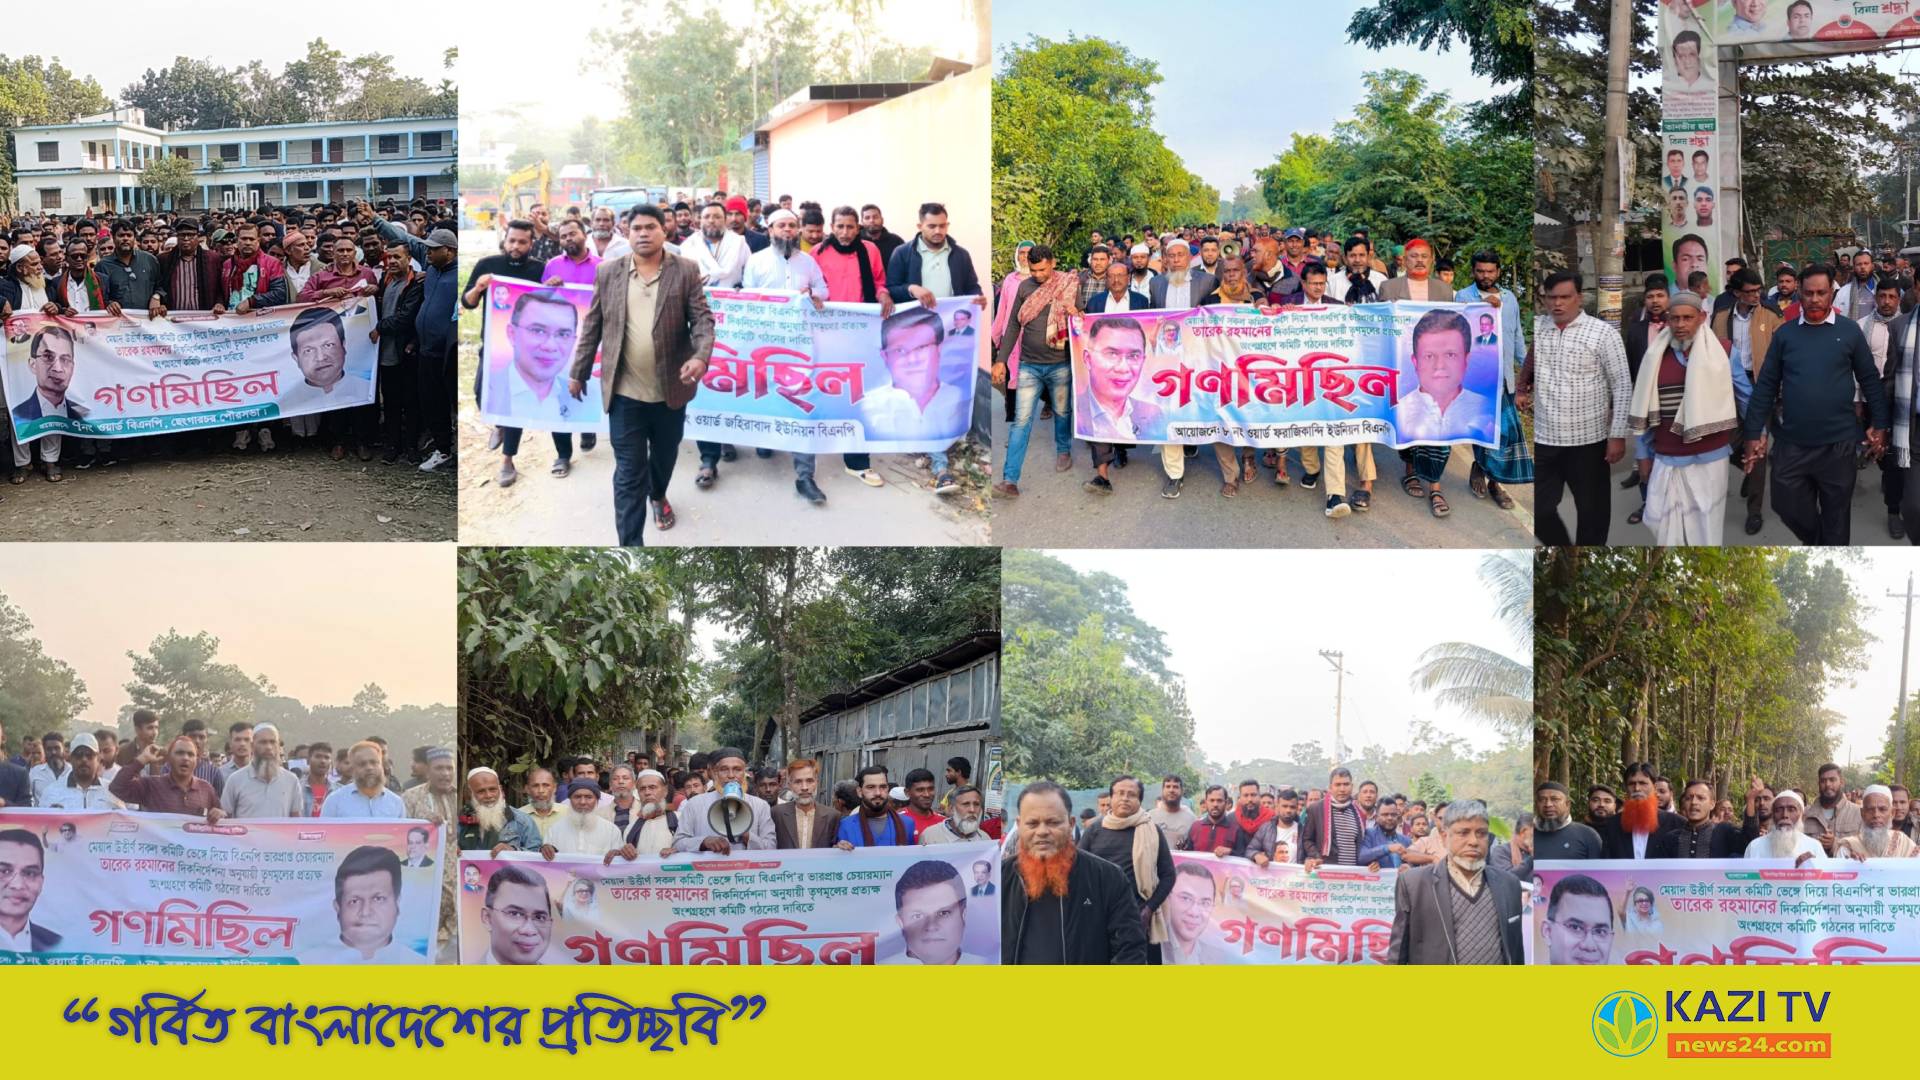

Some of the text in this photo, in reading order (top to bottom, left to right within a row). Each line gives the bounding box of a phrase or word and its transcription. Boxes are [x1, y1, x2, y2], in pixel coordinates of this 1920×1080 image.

[1192, 326, 1223, 338] তারেক
[1225, 325, 1272, 338] রহমানের
[94, 369, 279, 412] গণমিছিল
[1152, 352, 1401, 413] গণমিছিল
[695, 414, 722, 427] ওয়ার্ড
[724, 415, 771, 433] জহিরাবাদ
[774, 419, 815, 437] ইউনিয়ন
[818, 422, 855, 438] বিএনপি
[1247, 425, 1270, 440] ওয়ার্ড
[161, 842, 185, 856] কমিটি
[231, 848, 261, 862] বিএনপি
[100, 857, 131, 872] তারেক
[135, 858, 176, 873] রহমানের
[189, 877, 212, 892] কমিটি
[244, 883, 271, 897] দাবিতে
[655, 876, 676, 885] সকল
[679, 873, 704, 885] কমিটি
[707, 874, 731, 886] ভেঙ্গে
[735, 872, 755, 885] দিয়ে
[758, 870, 804, 884] বিএনপি'র
[808, 871, 842, 882] ভারপ্রাপ্ত
[847, 870, 893, 882] চেয়ারম্যান
[610, 885, 880, 903] তারেক রহমানের দিকনির্দেশনা অনুযায়ী তৃণমূলের প্রত্যক্ষ
[1288, 890, 1328, 904] রহমানের
[1659, 885, 1686, 896] মেয়াদ
[1718, 886, 1741, 897] সকল
[1745, 882, 1773, 897] কমিটি
[1776, 885, 1801, 898] ভেঙ্গে
[1805, 883, 1828, 898] দিয়ে
[1832, 882, 1884, 897] বিএনপি'র
[1888, 886, 1920, 898] ভারপ্রা
[672, 900, 814, 917] অংশগ্রহণে কমিটি গঠনের দাবিতে
[1671, 897, 1713, 914] তারেক
[1719, 897, 1778, 915] রহমানের
[1780, 900, 1841, 917] দিকনির্দেশনা
[1844, 900, 1884, 917] অনুযায়ী
[89, 898, 298, 955] গণমিছিল
[1737, 918, 1896, 934] অংশগ্রহণে কমিটি গঠনের দাবিতে
[1219, 915, 1393, 965] গণমিছি
